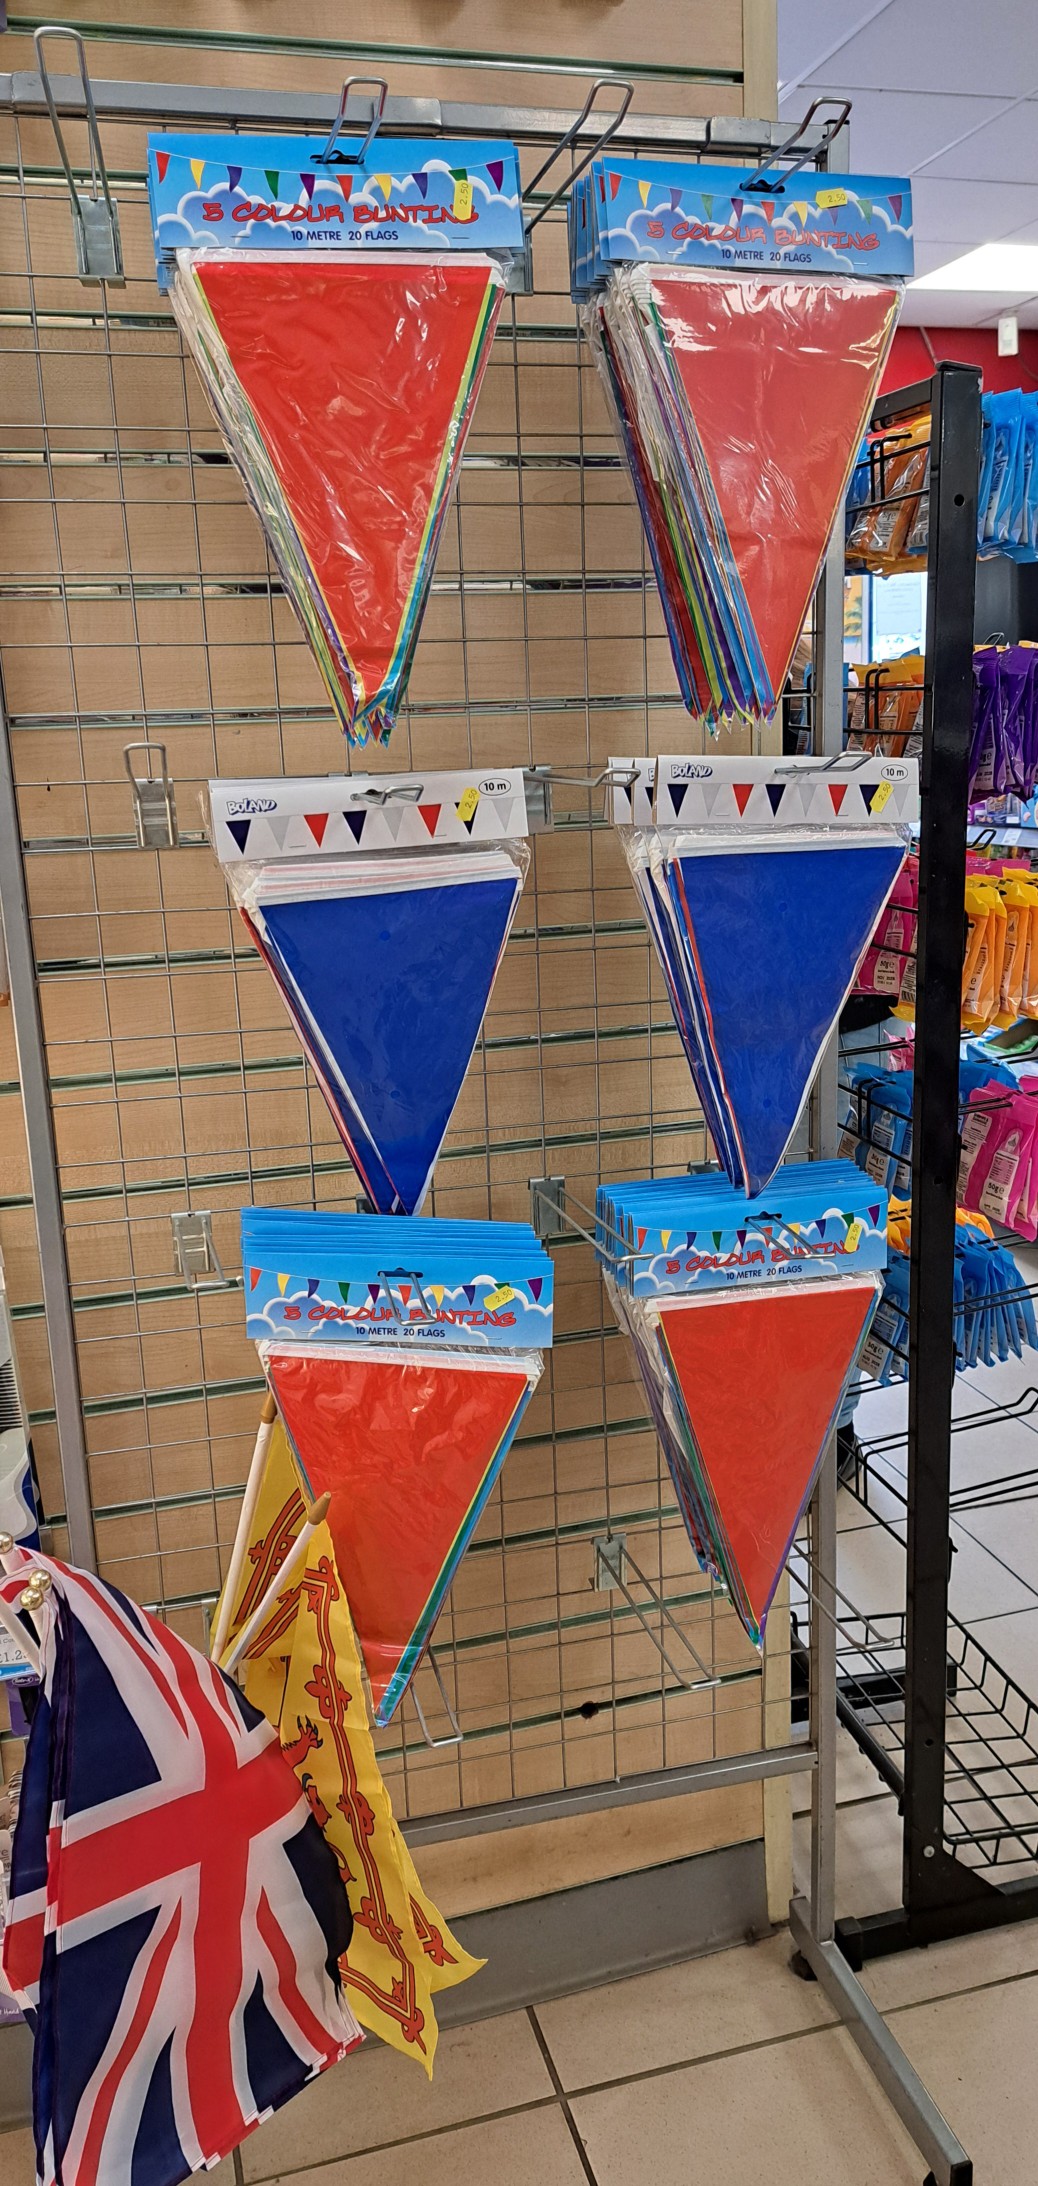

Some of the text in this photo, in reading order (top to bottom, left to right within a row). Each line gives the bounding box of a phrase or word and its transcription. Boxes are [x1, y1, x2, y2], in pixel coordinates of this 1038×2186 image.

[460, 182, 469, 206] 2.50
[827, 193, 846, 203] 2.50
[202, 202, 224, 222] 5
[231, 201, 345, 223] COLOUR
[291, 230, 399, 241] 10 METRE 20 FLAGS
[646, 220, 880, 251] 5 COLOUR BUNTING
[721, 249, 812, 263] 10 METRE 20 FLAGS
[886, 768, 905, 777] 10 m
[484, 782, 495, 791] 10
[878, 783, 891, 801] 2.50
[464, 789, 478, 809] 2.50
[850, 1224, 860, 1241] 2.50
[665, 1259, 681, 1275] 5
[685, 1249, 765, 1272] COLOUR
[726, 1265, 803, 1280] 10 METRE 20 FLAGS
[495, 1288, 513, 1303] 2.50
[283, 1306, 302, 1320] 5
[355, 1326, 446, 1338] 10 METRE 20 FLAGS
